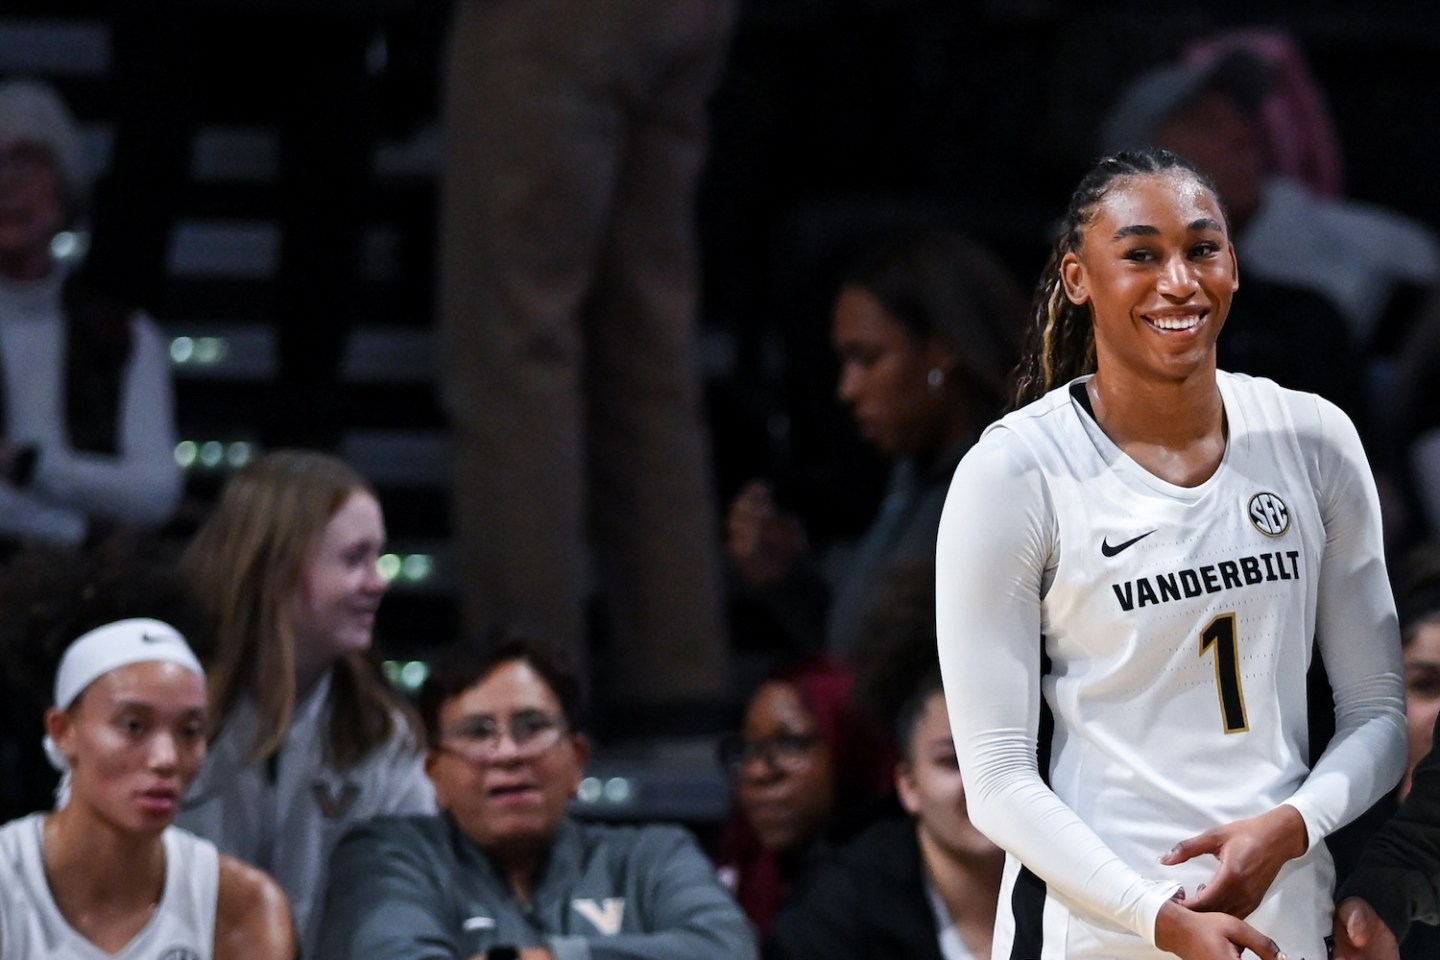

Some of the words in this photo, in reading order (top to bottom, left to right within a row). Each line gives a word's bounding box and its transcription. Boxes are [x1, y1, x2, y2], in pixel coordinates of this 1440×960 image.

[1249, 493, 1289, 535] SEC
[1112, 551, 1300, 612] VANDERBILT
[1199, 612, 1250, 735] 1
[571, 898, 626, 935] V
